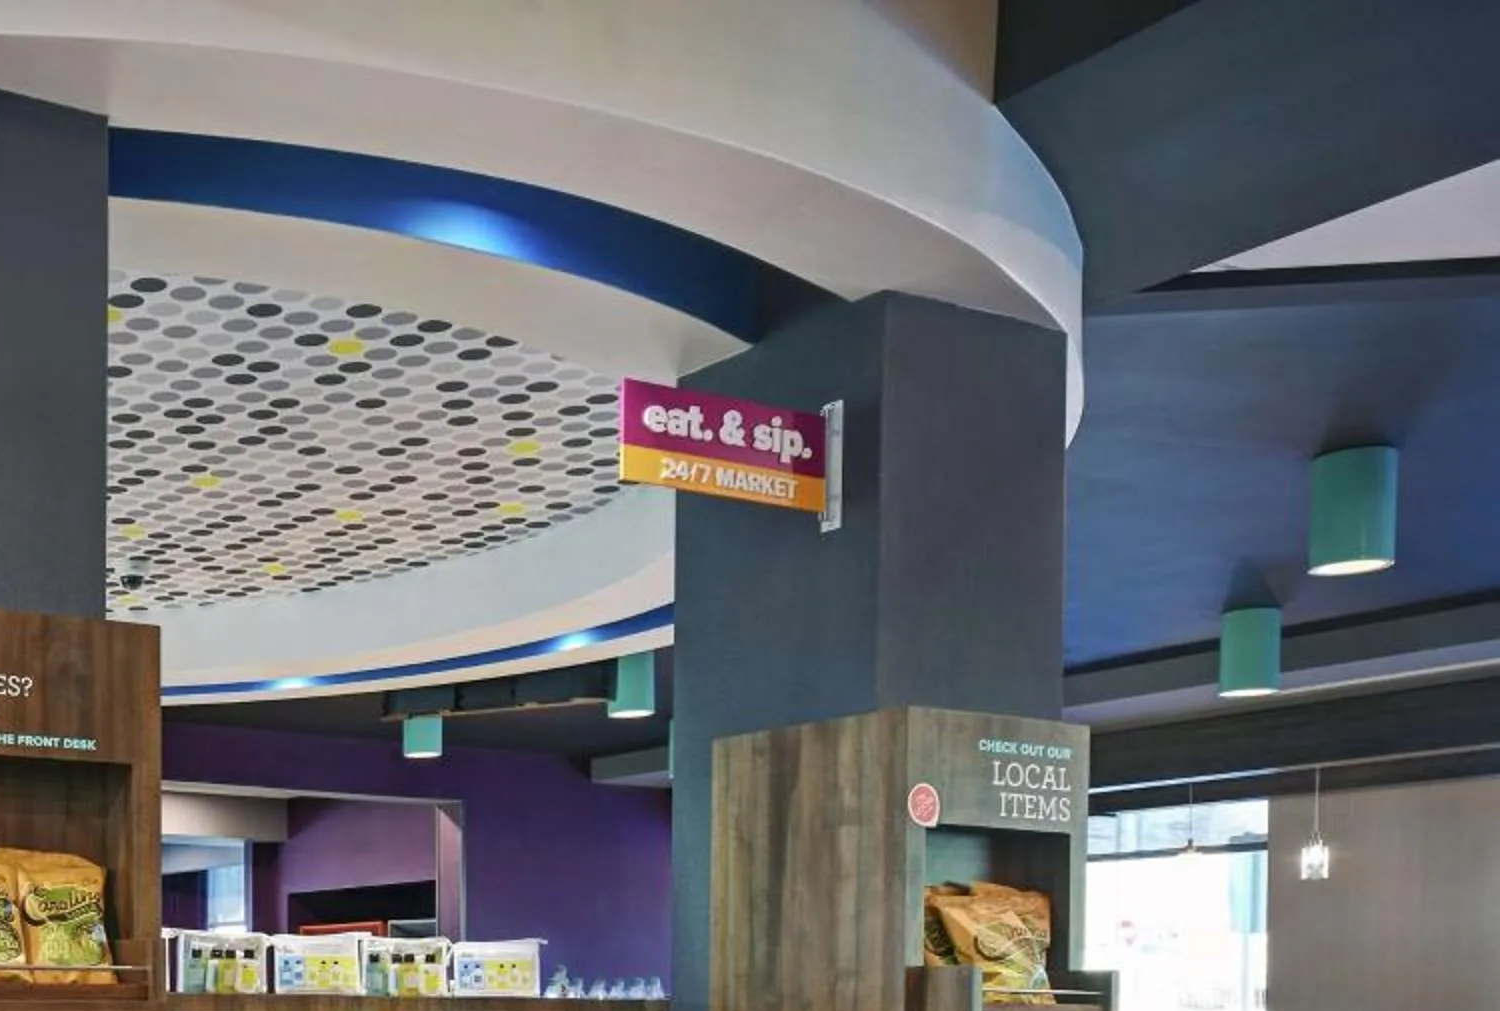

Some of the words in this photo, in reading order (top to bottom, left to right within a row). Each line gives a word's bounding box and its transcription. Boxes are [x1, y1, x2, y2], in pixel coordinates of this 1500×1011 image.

[643, 405, 713, 441] eat.
[719, 410, 746, 447] &
[752, 416, 812, 463] sip.
[660, 458, 710, 484] 24/7
[715, 466, 798, 499] MARKET
[17, 735, 60, 748] FRONT
[63, 738, 97, 751] DESK
[979, 739, 1018, 753] CHECK
[1021, 743, 1044, 757] OUT
[1047, 746, 1072, 759] OUR
[992, 761, 1071, 791] LOCAL
[1000, 792, 1071, 822] ITEMS
